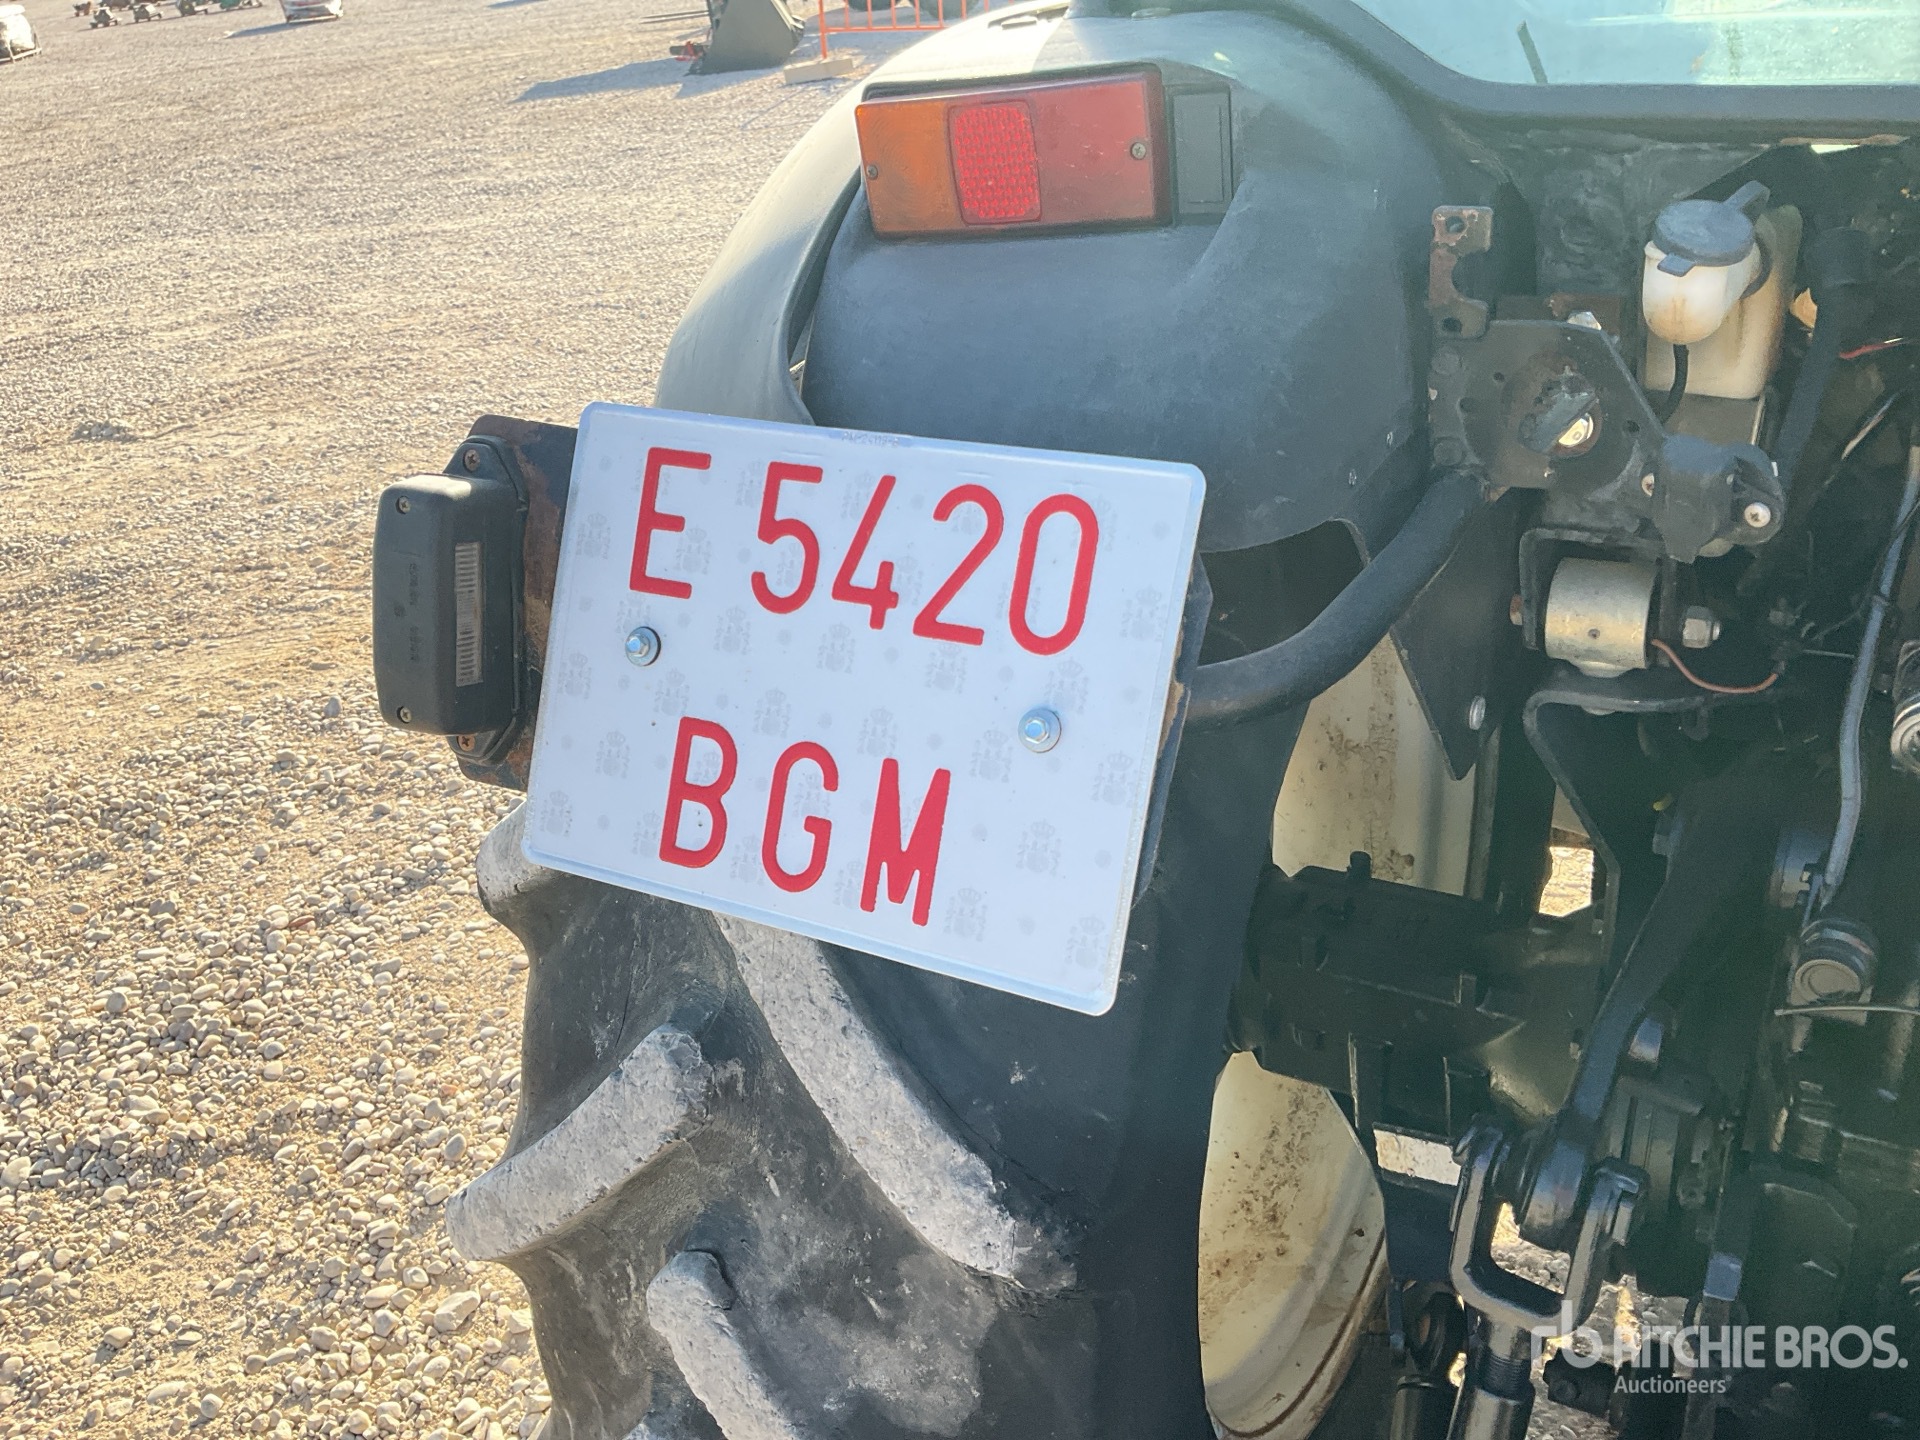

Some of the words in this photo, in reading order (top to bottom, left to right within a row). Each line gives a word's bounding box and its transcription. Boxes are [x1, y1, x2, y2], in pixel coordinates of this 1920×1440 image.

[630, 447, 711, 598] E
[752, 462, 1098, 655] 5420
[660, 717, 950, 925] BGM
